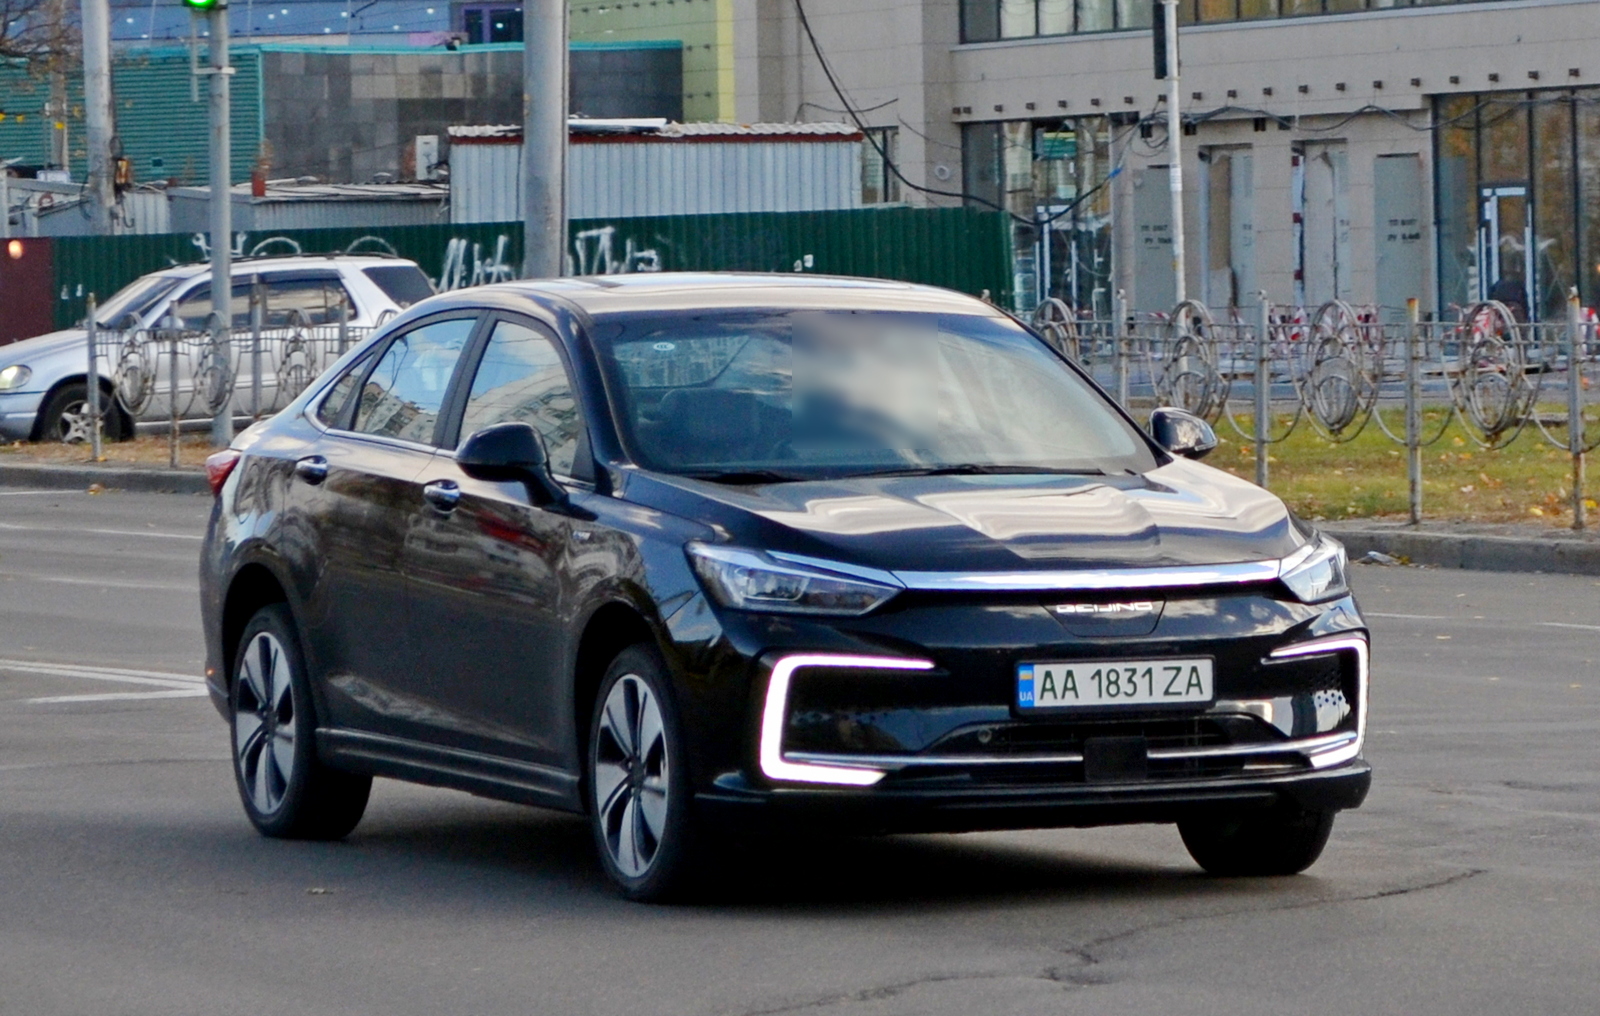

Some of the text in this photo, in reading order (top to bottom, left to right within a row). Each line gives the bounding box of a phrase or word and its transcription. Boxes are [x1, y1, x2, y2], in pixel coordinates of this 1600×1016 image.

[1039, 665, 1204, 700] AA 1831 ZA
[1019, 691, 1034, 702] UA
